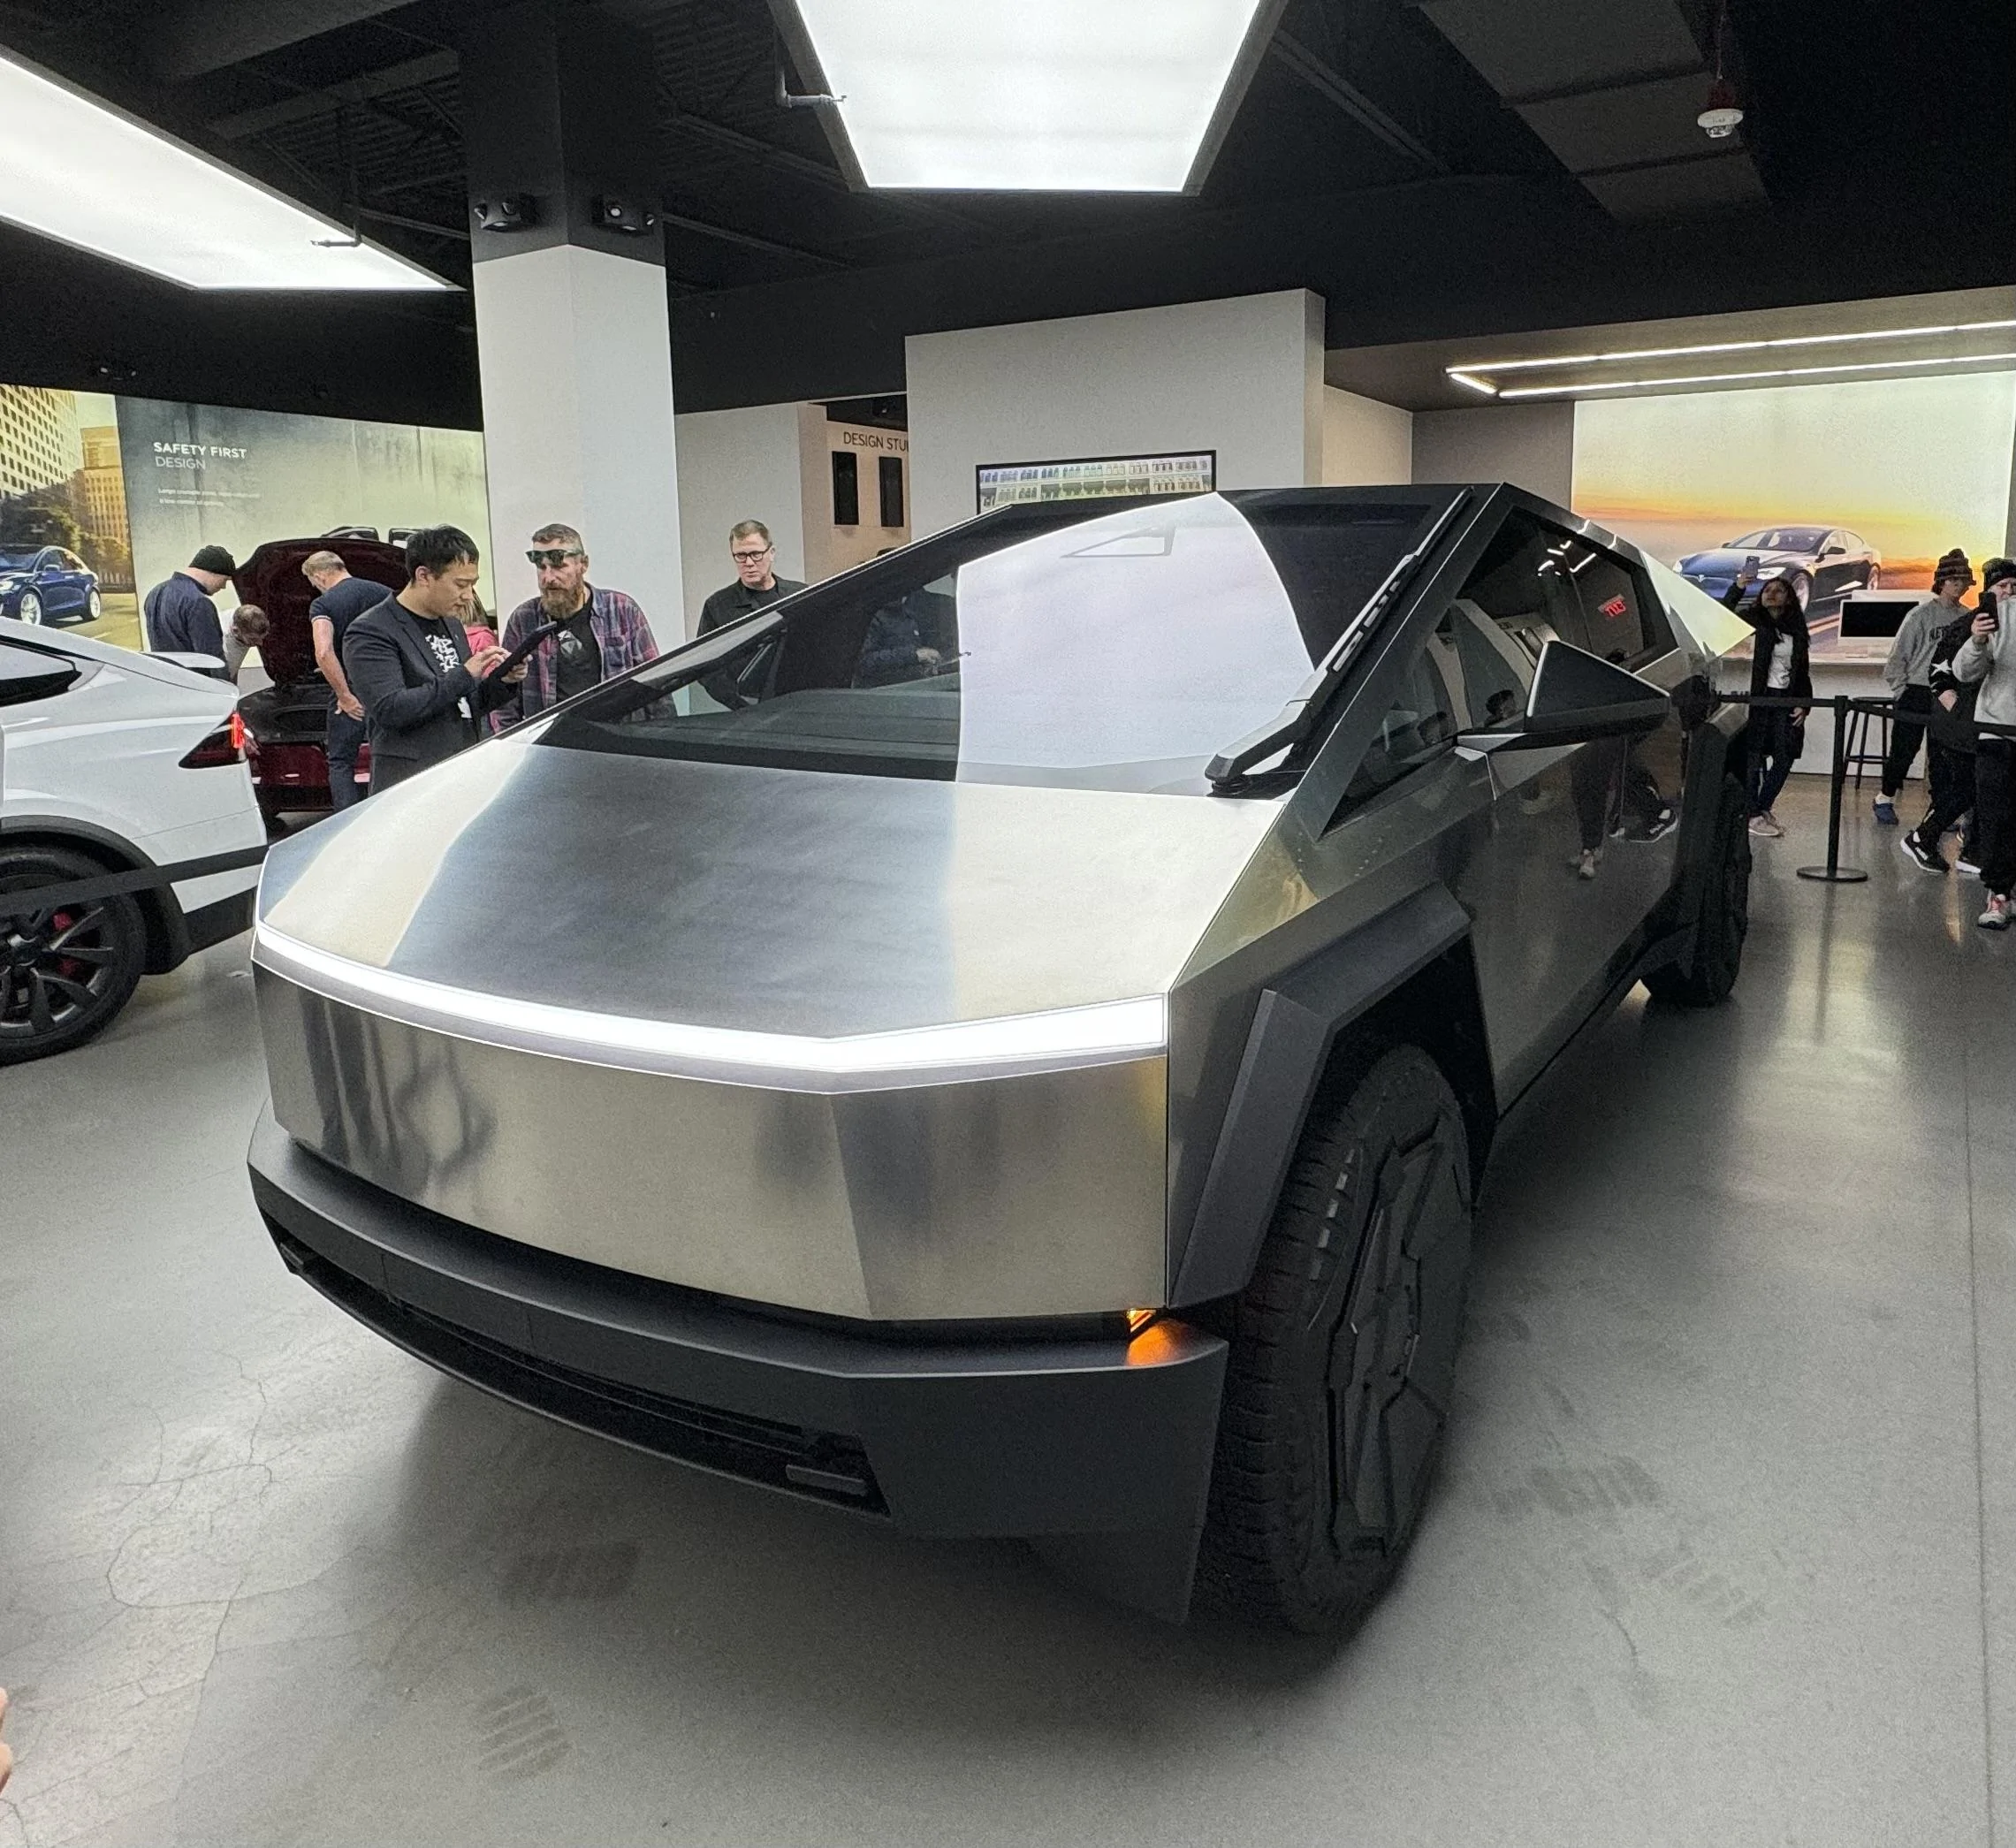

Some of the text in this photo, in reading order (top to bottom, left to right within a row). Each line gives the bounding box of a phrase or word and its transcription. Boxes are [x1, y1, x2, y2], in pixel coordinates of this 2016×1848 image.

[843, 431, 909, 452] DESIGN STU
[153, 442, 247, 460] SAFETY FIRST
[155, 456, 206, 470] DESIGN
